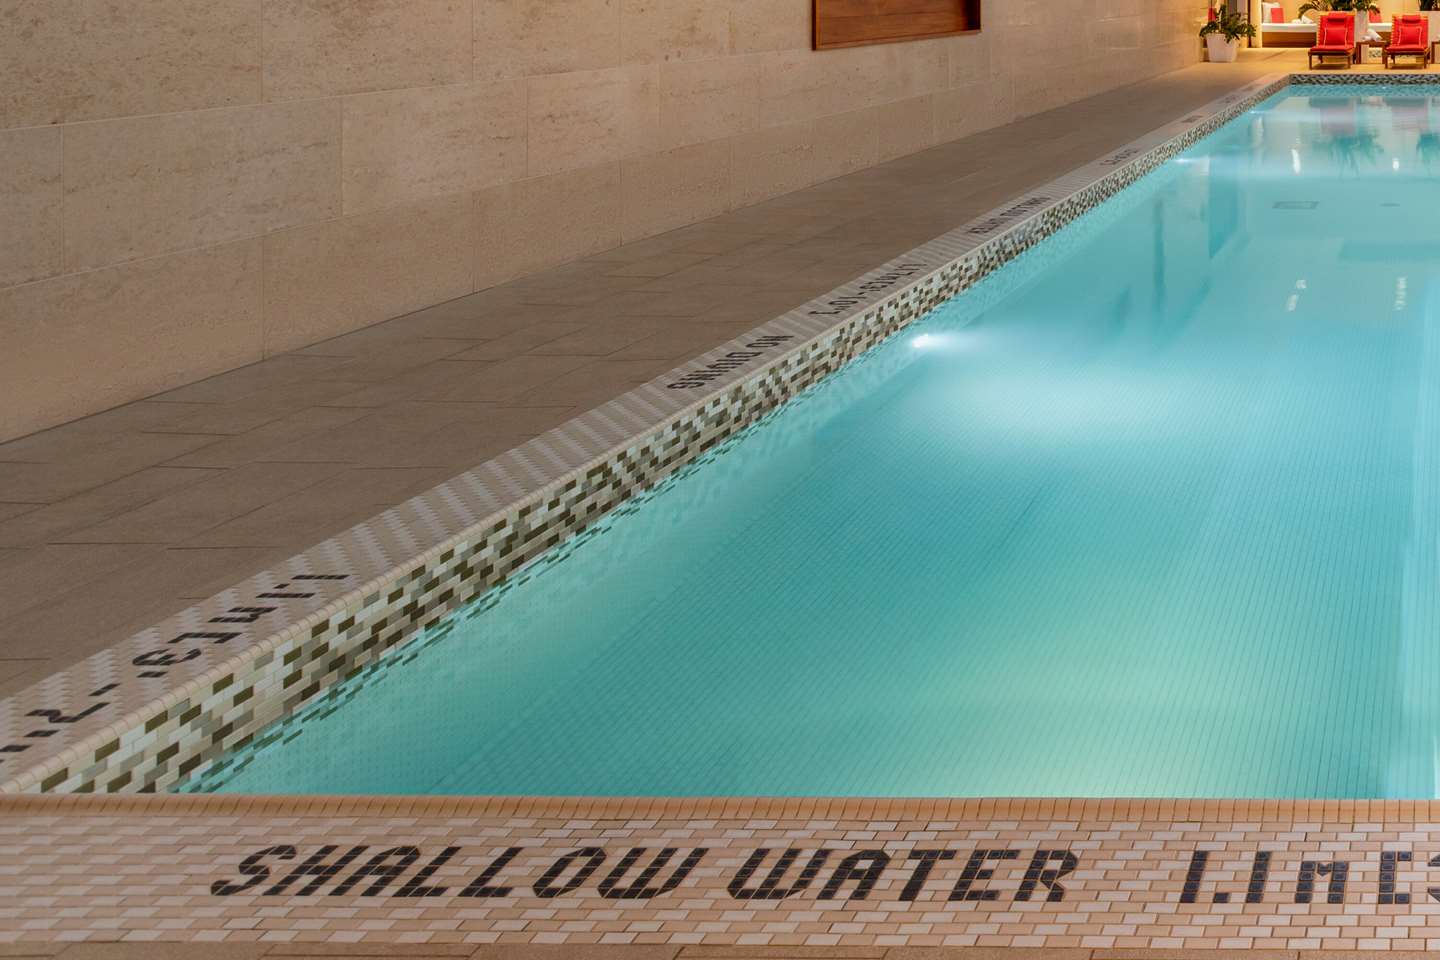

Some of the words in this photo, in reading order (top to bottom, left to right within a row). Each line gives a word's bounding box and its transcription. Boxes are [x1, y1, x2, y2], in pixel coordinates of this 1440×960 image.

[746, 335, 794, 348] NO
[666, 351, 763, 389] DIVING
[210, 845, 709, 898] SHALLOW
[726, 848, 1079, 902] WATER
